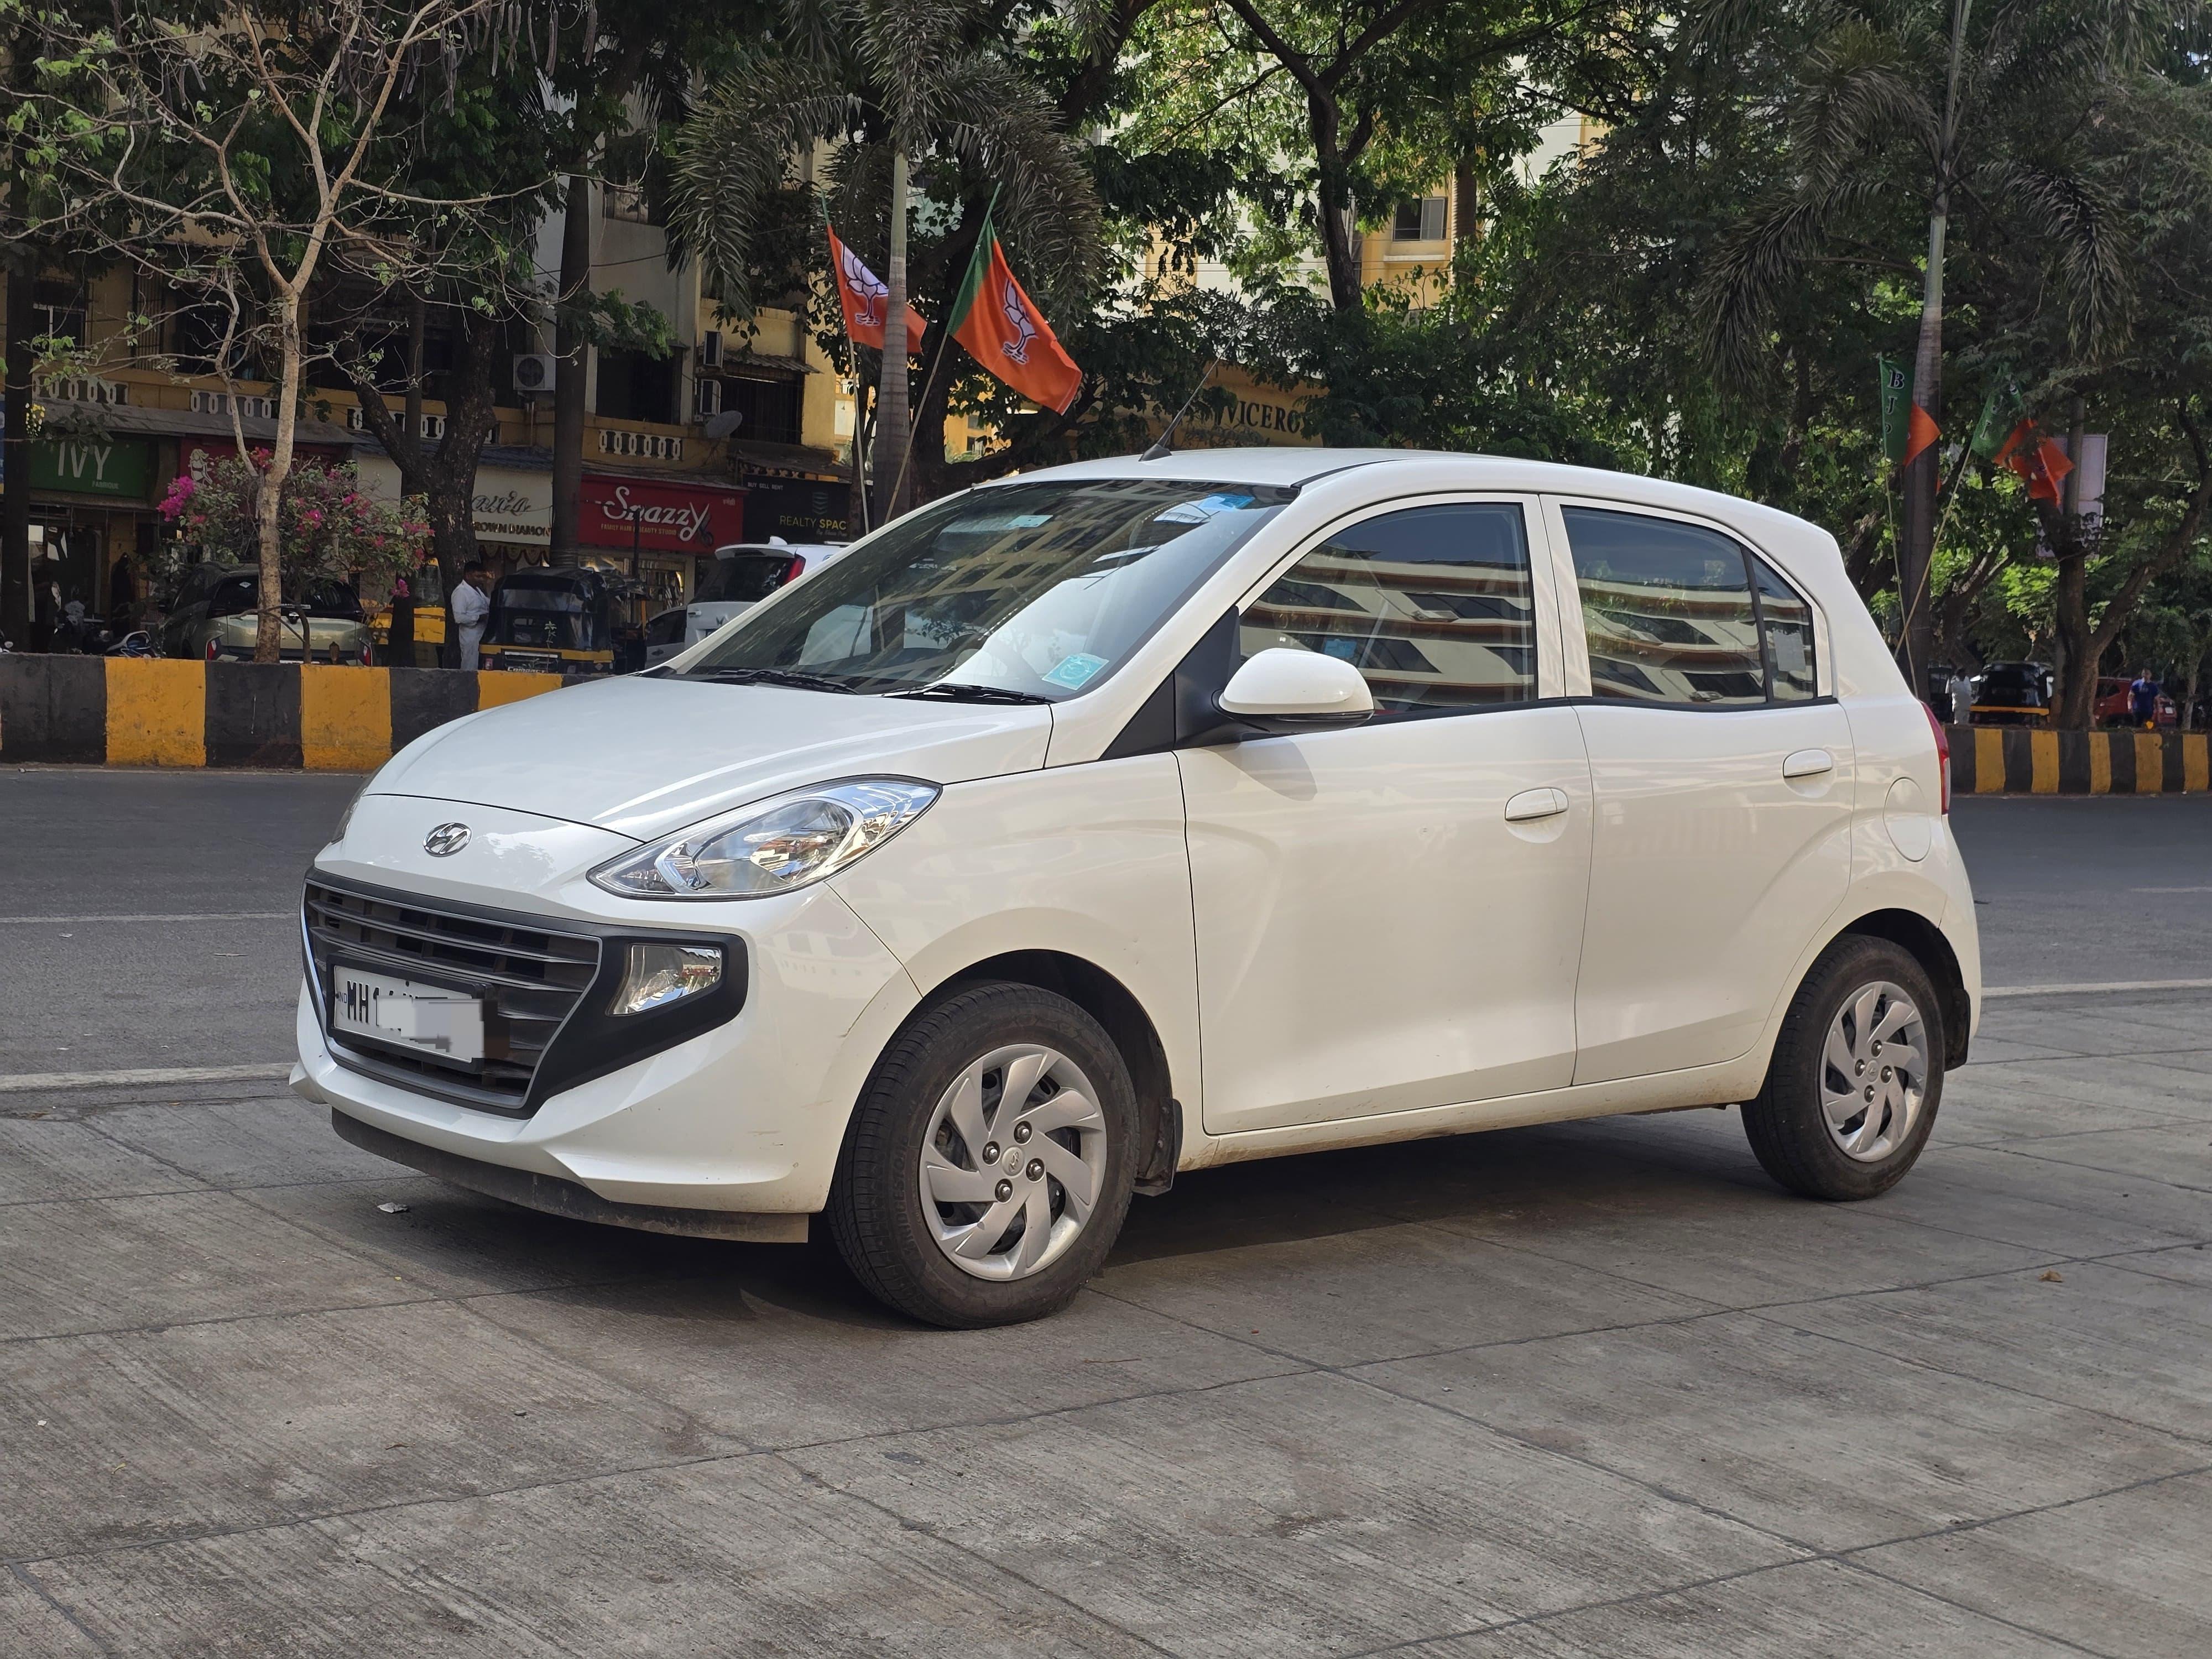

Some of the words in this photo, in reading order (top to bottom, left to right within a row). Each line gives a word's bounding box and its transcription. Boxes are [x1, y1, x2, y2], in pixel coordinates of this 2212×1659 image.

[1225, 400, 1302, 434] VICERO
[58, 442, 112, 480] IVY
[508, 524, 551, 536] DIAMON
[603, 486, 709, 541] Snazzy
[780, 515, 817, 528] REALTY
[819, 518, 847, 530] SPAC
